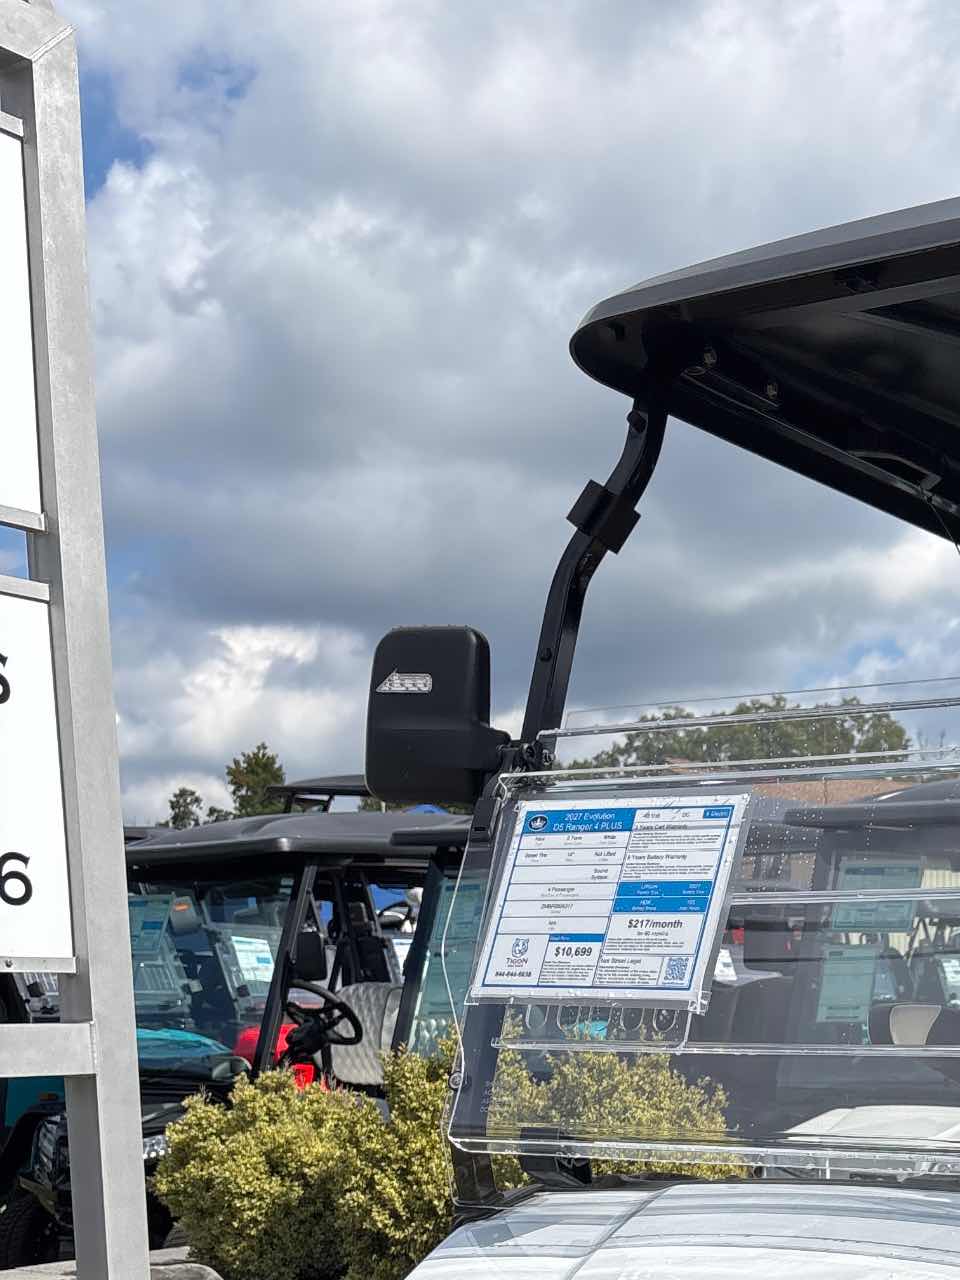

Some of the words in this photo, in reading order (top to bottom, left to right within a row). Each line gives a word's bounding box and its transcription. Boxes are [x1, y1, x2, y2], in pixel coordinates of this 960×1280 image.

[564, 812, 583, 821] 2027
[584, 811, 616, 821] Evolution
[565, 822, 593, 832] Ranger
[600, 821, 623, 830] PLUS
[627, 919, 684, 929] $217/month
[554, 946, 593, 958] $10,699
